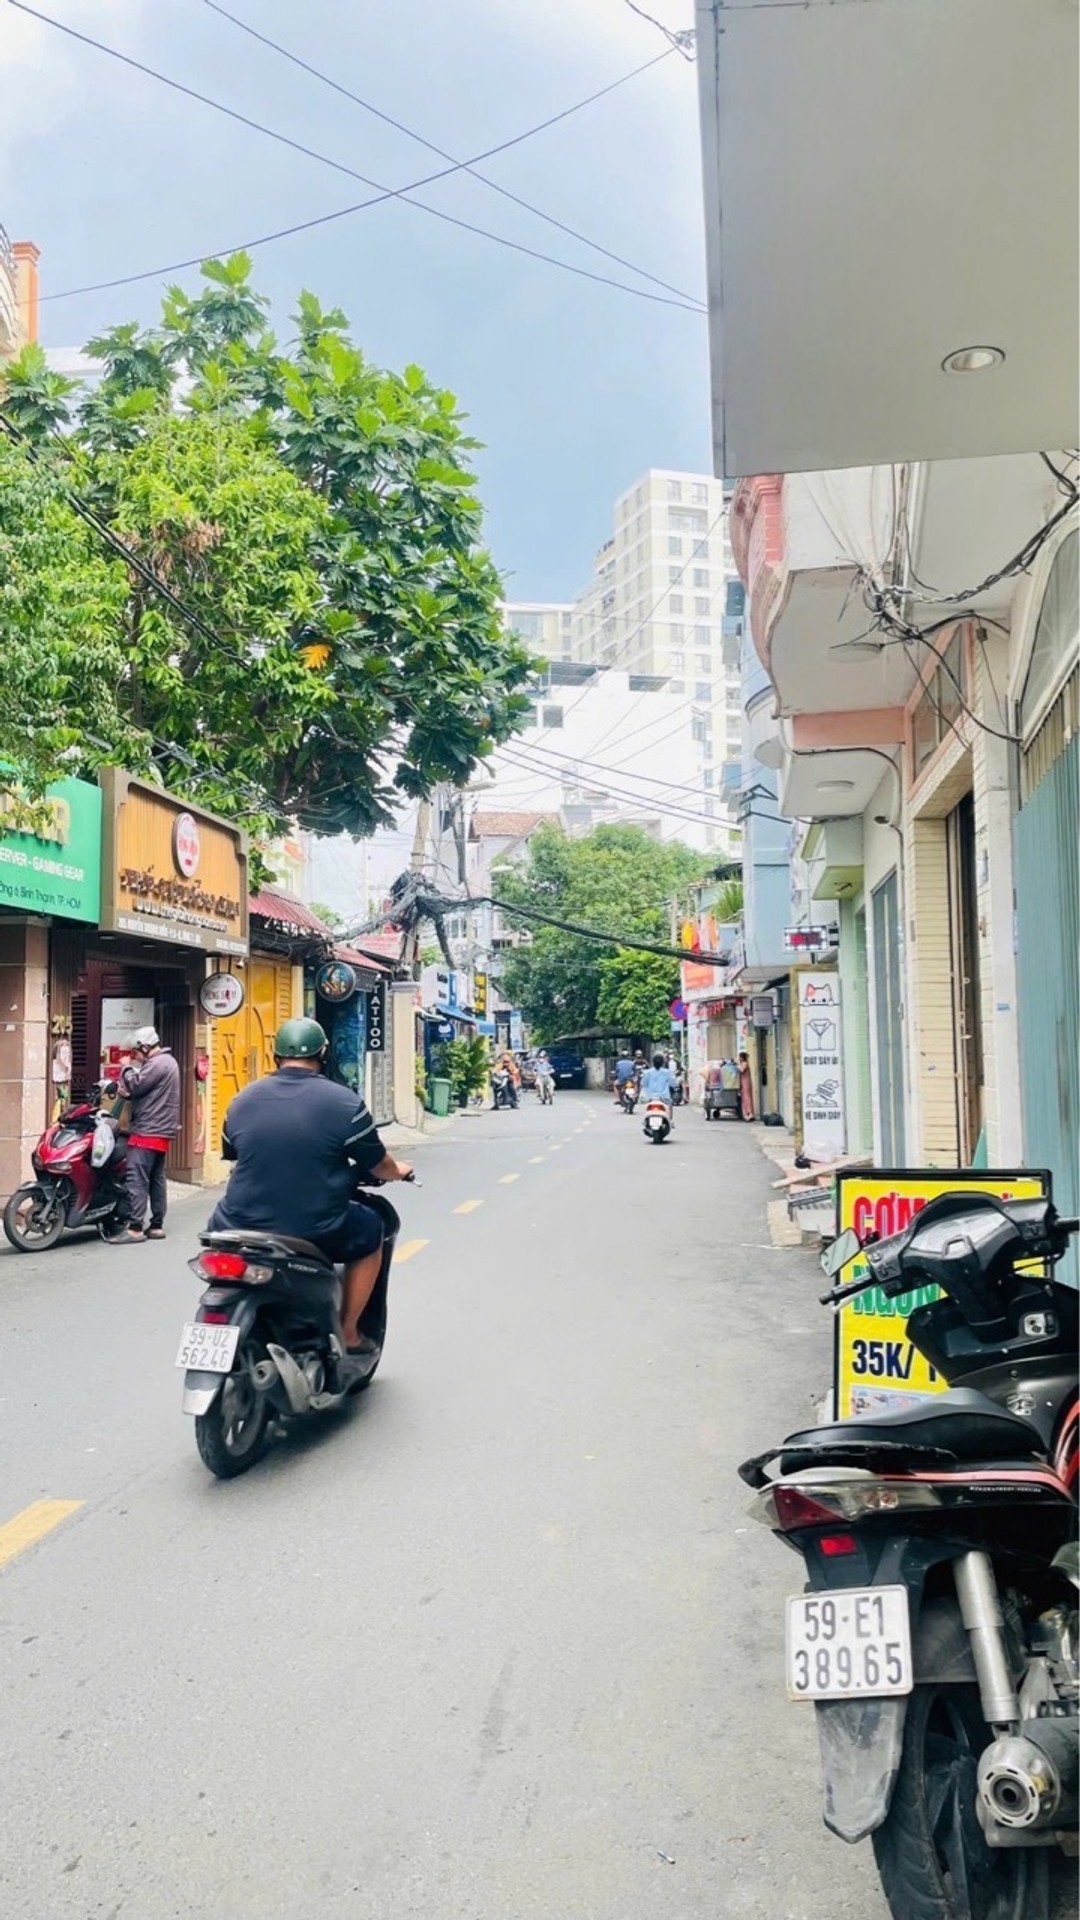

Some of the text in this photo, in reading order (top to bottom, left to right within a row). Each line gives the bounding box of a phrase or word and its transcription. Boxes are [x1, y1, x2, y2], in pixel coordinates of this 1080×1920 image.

[0, 847, 28, 867] ERVER
[370, 985, 381, 1048] TATTOO
[189, 1327, 231, 1348] 59-U2
[805, 1596, 884, 1641] 59-E1
[795, 1641, 902, 1690] 389.65
